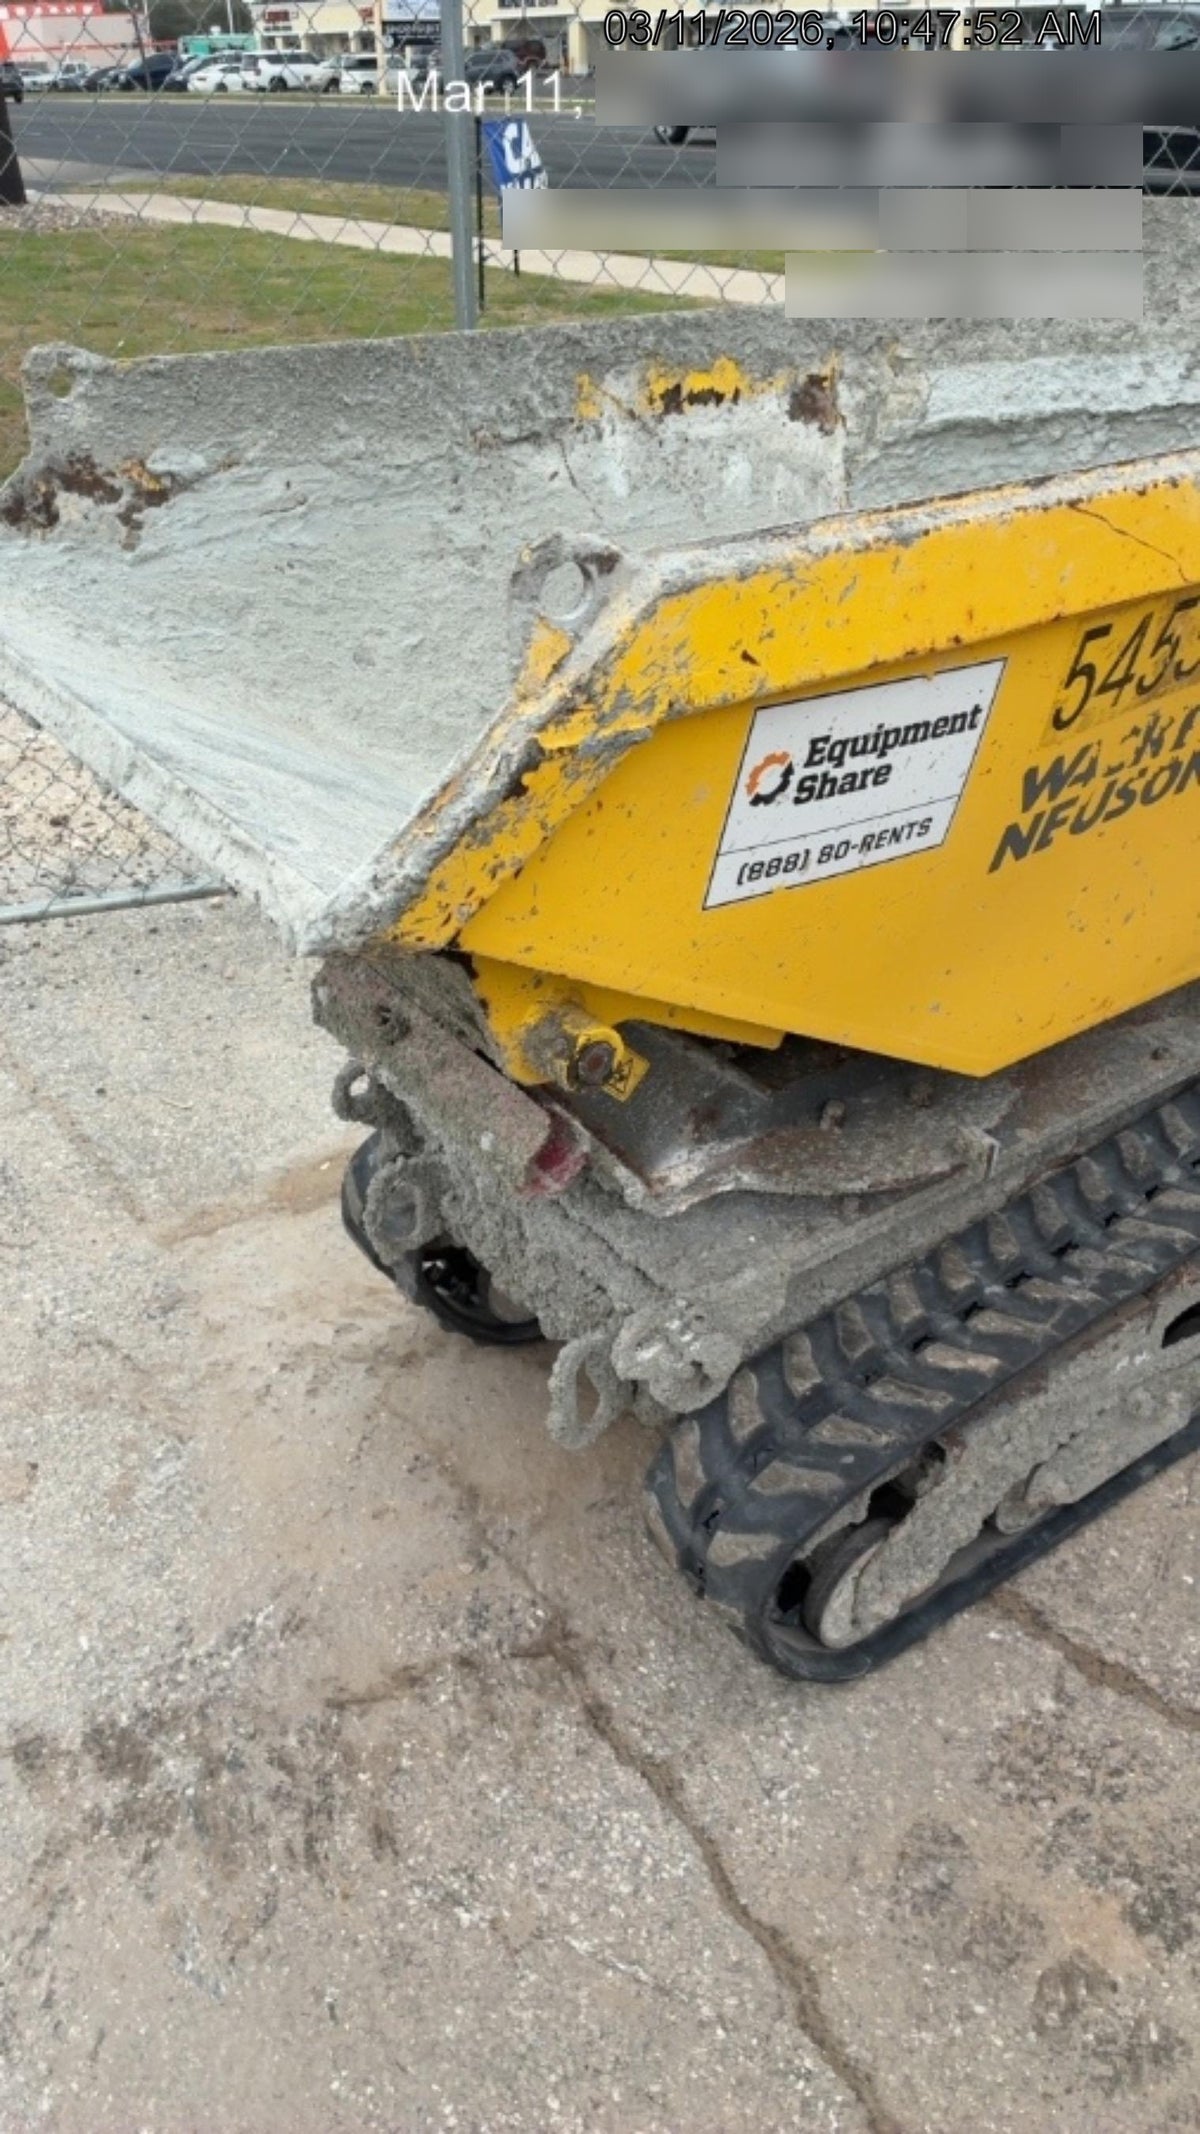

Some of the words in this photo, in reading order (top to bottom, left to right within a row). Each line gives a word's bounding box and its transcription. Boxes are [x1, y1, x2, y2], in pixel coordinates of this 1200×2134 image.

[803, 703, 983, 769] Equipment
[793, 763, 893, 806] Share
[736, 848, 811, 886] (888)
[816, 816, 934, 865] 80-RENTS
